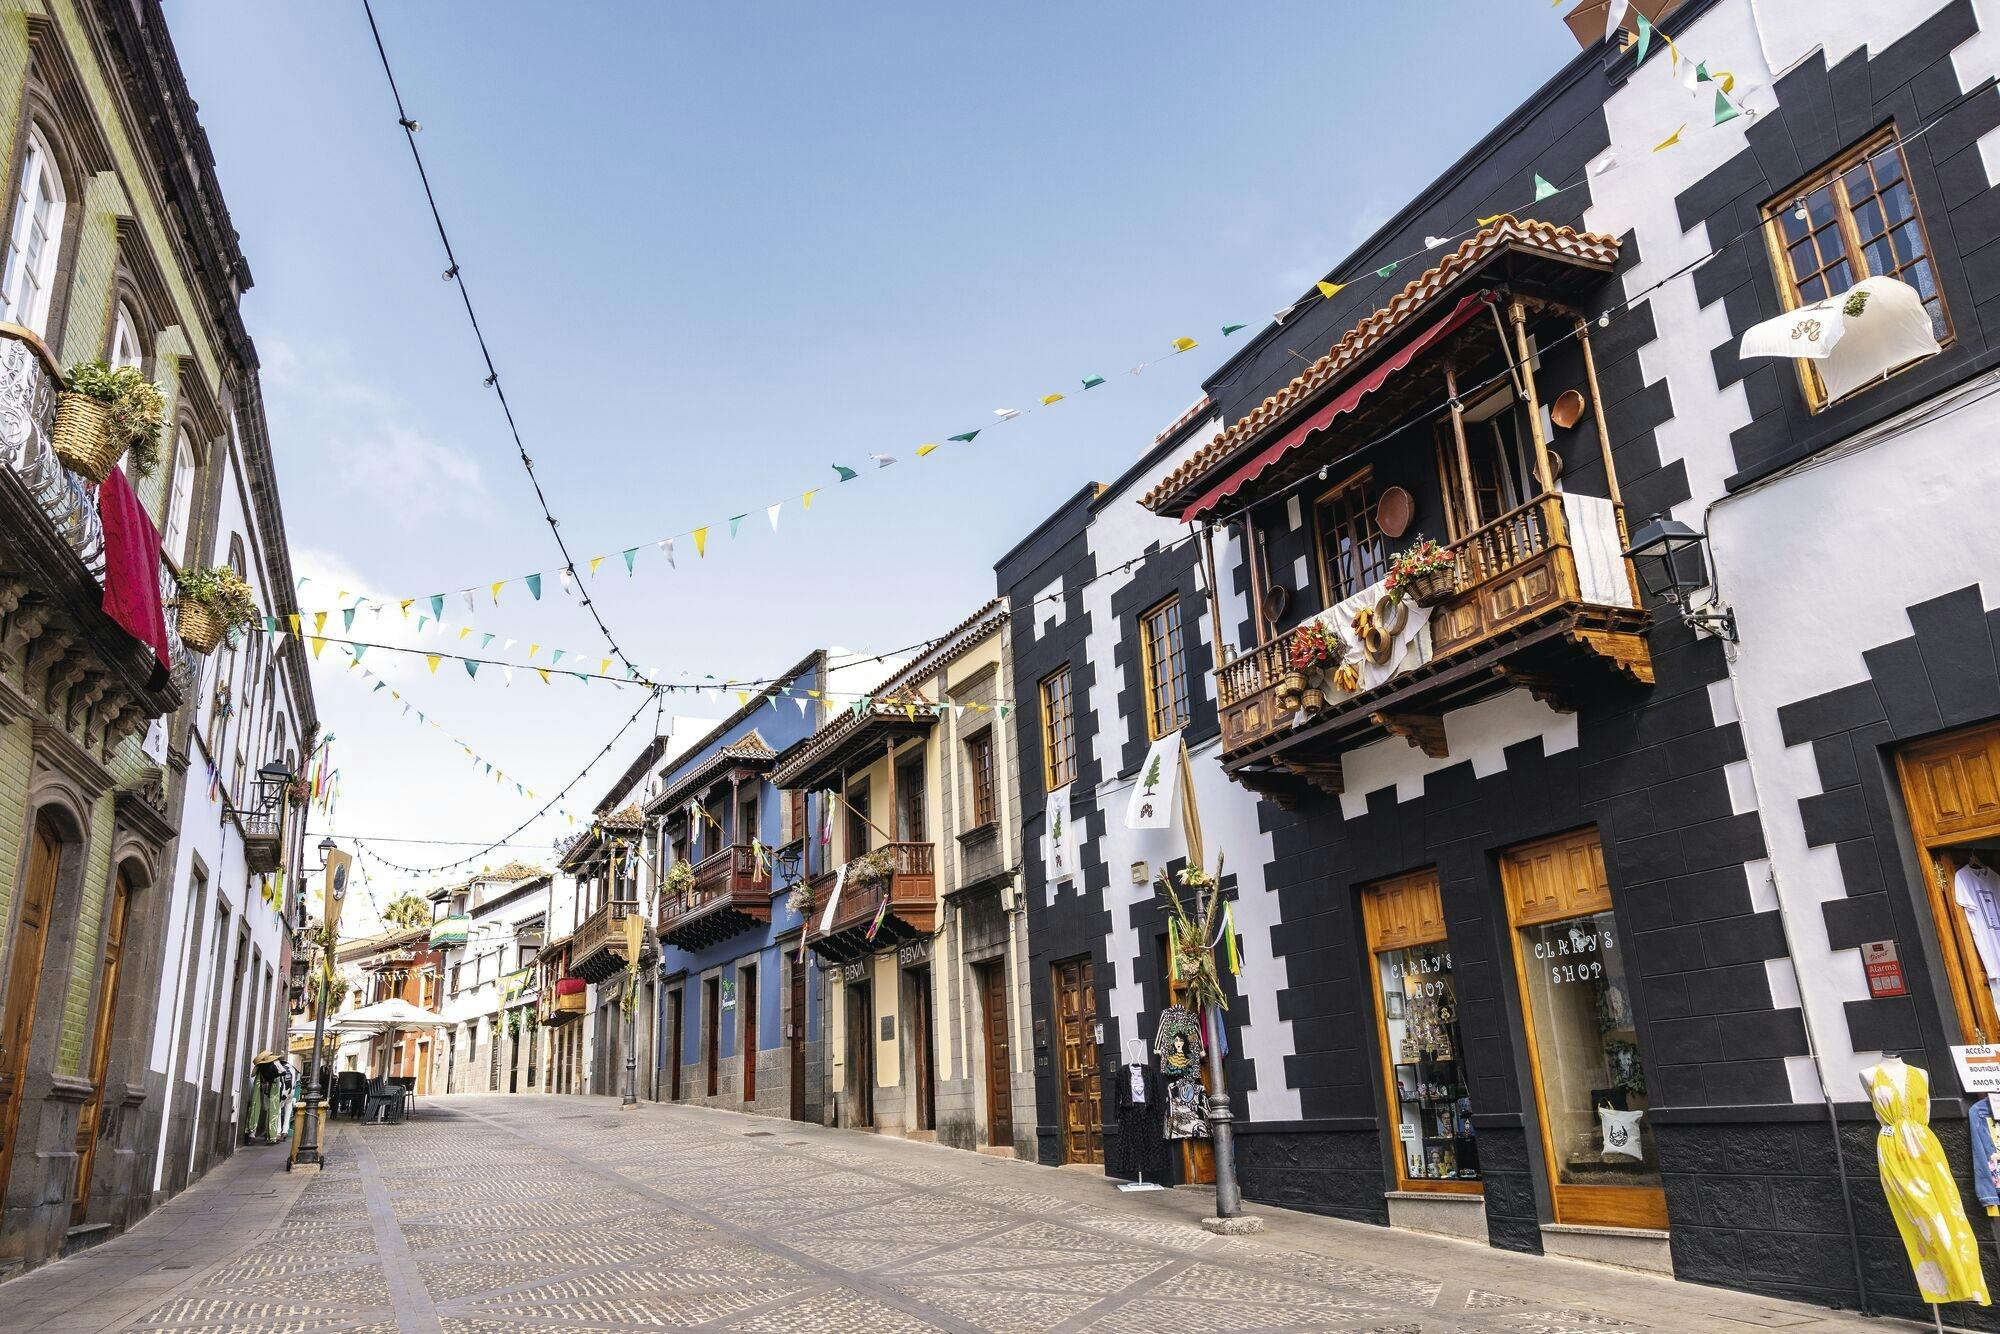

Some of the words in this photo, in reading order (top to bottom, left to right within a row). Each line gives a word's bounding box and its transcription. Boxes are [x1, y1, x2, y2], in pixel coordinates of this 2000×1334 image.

[901, 941, 926, 965] BBVA
[1535, 931, 1613, 959] CLARY'S
[845, 960, 865, 981] BBVA
[1391, 953, 1452, 979] CLARY'S
[1552, 961, 1602, 984] SHOP
[1869, 964, 1898, 974] Alarma
[1965, 1046, 1991, 1054] ACCESO
